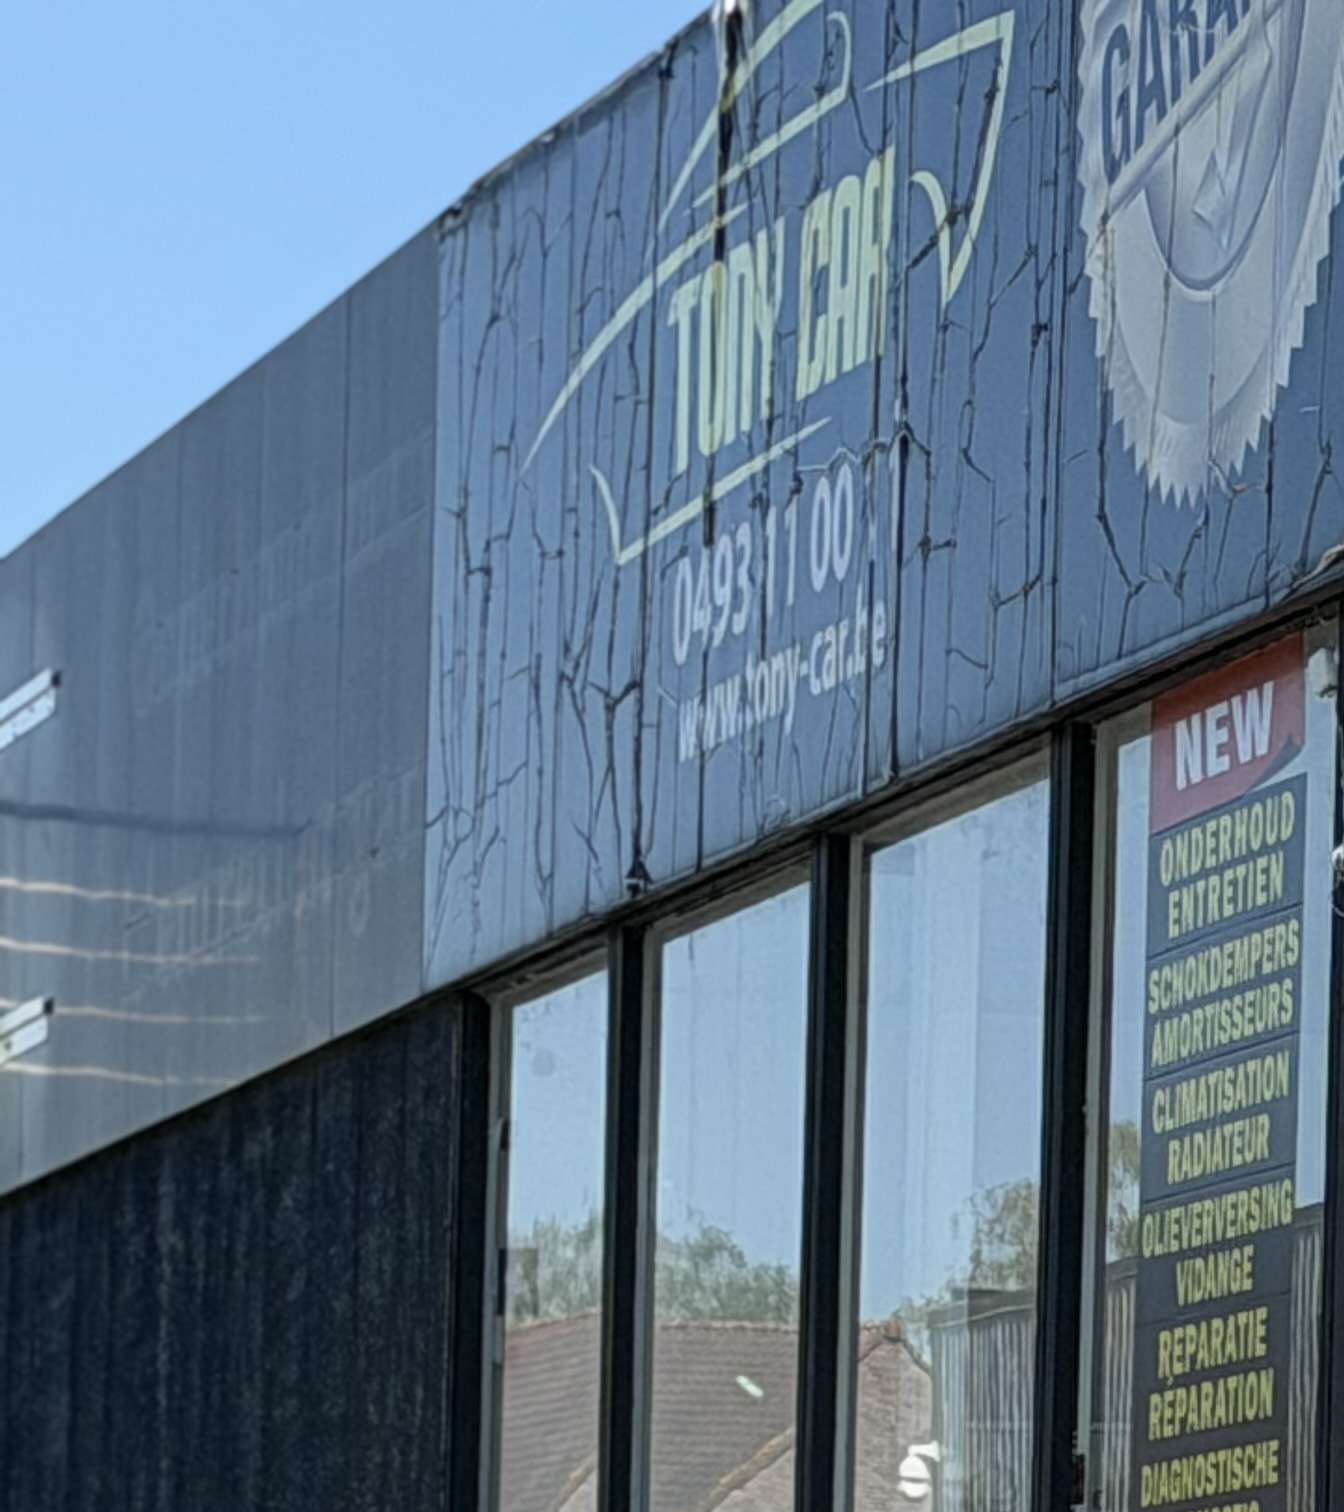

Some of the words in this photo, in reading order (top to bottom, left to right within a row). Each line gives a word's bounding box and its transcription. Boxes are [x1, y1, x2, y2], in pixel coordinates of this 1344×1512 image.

[667, 215, 785, 475] TONY
[796, 143, 896, 401] CAR
[809, 462, 853, 593] 00
[1173, 681, 1276, 791] NEW
[1159, 790, 1296, 887] ONDERHOUD
[1167, 850, 1285, 939] ENTRETIEN
[1147, 919, 1300, 1015] SCHOKDEMPERS
[1151, 978, 1294, 1069] AMORTISSEURS
[1151, 1051, 1291, 1135] CLIMATISATION
[1167, 1114, 1271, 1186] RADIATEUR
[1142, 1178, 1293, 1259] OLIEVERVERSING
[1176, 1244, 1255, 1307] VIDANGE
[1158, 1306, 1270, 1379] REPARATIE
[1140, 1440, 1280, 1508] DIAGNOSTISCHE
